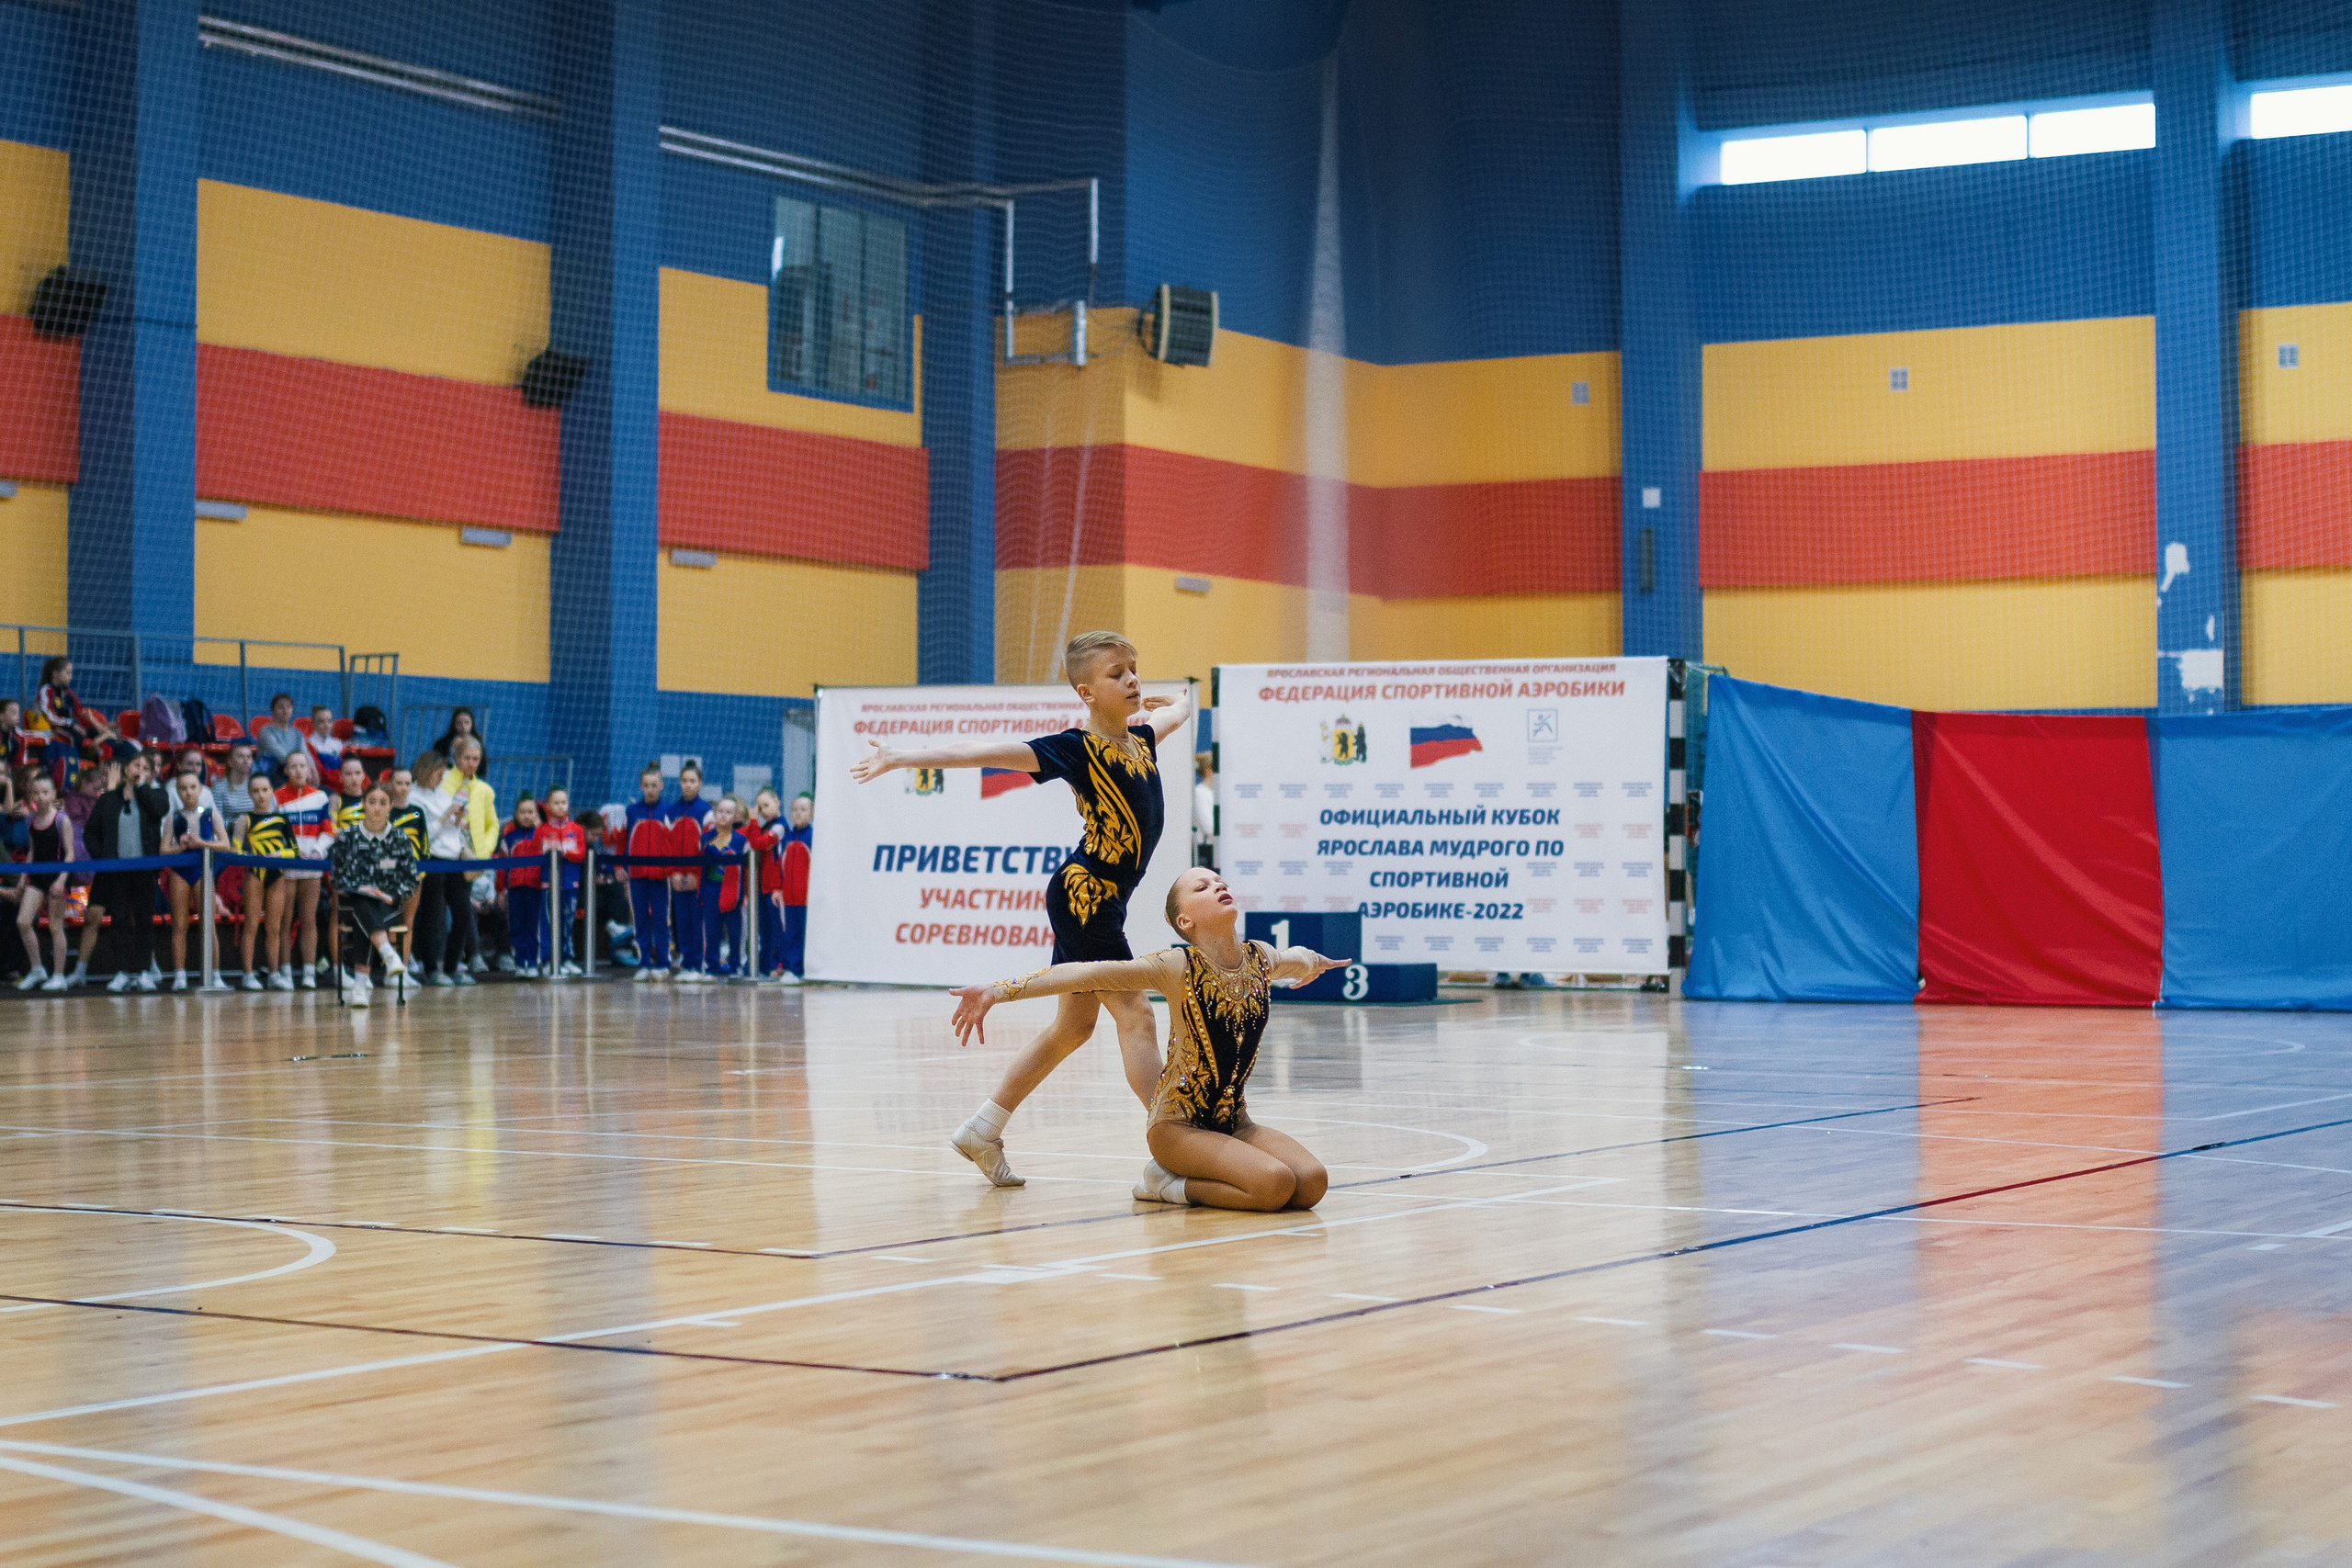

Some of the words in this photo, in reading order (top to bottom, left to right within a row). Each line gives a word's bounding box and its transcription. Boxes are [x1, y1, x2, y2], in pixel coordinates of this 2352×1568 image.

[1267, 668, 1345, 678] ЯРОСЛАВСКАЯ
[1348, 666, 1435, 676] РЕГИОНАЛЬНАЯ
[1438, 664, 1530, 675] ОБЩЕСТВЕННАЯ
[1532, 663, 1617, 673] ОРГАНИЗАЦИЯ
[1259, 684, 1377, 703] ФЕДЕРАЦИЯ
[1382, 679, 1513, 700] СПОРТИВНОЙ
[1517, 681, 1625, 697] АЭРОБИКИ
[854, 719, 954, 737] ФЕДЕРАЦИЯ
[957, 714, 1069, 734] СПОРТИВНОЙ
[1319, 805, 1487, 829] ОФИЦИАЛЬНЫЙ
[1491, 808, 1561, 826] КУБОК
[1317, 840, 1424, 856] ЯРОСЛАВА
[1430, 840, 1530, 860] МУДРОГО
[1535, 840, 1565, 856] ПО
[1369, 866, 1510, 888] СПОРТИВНОЙ
[1357, 901, 1524, 919] АЭРОБИКЕ-2022
[1271, 919, 1290, 951] 1
[1342, 964, 1369, 1000] 3
